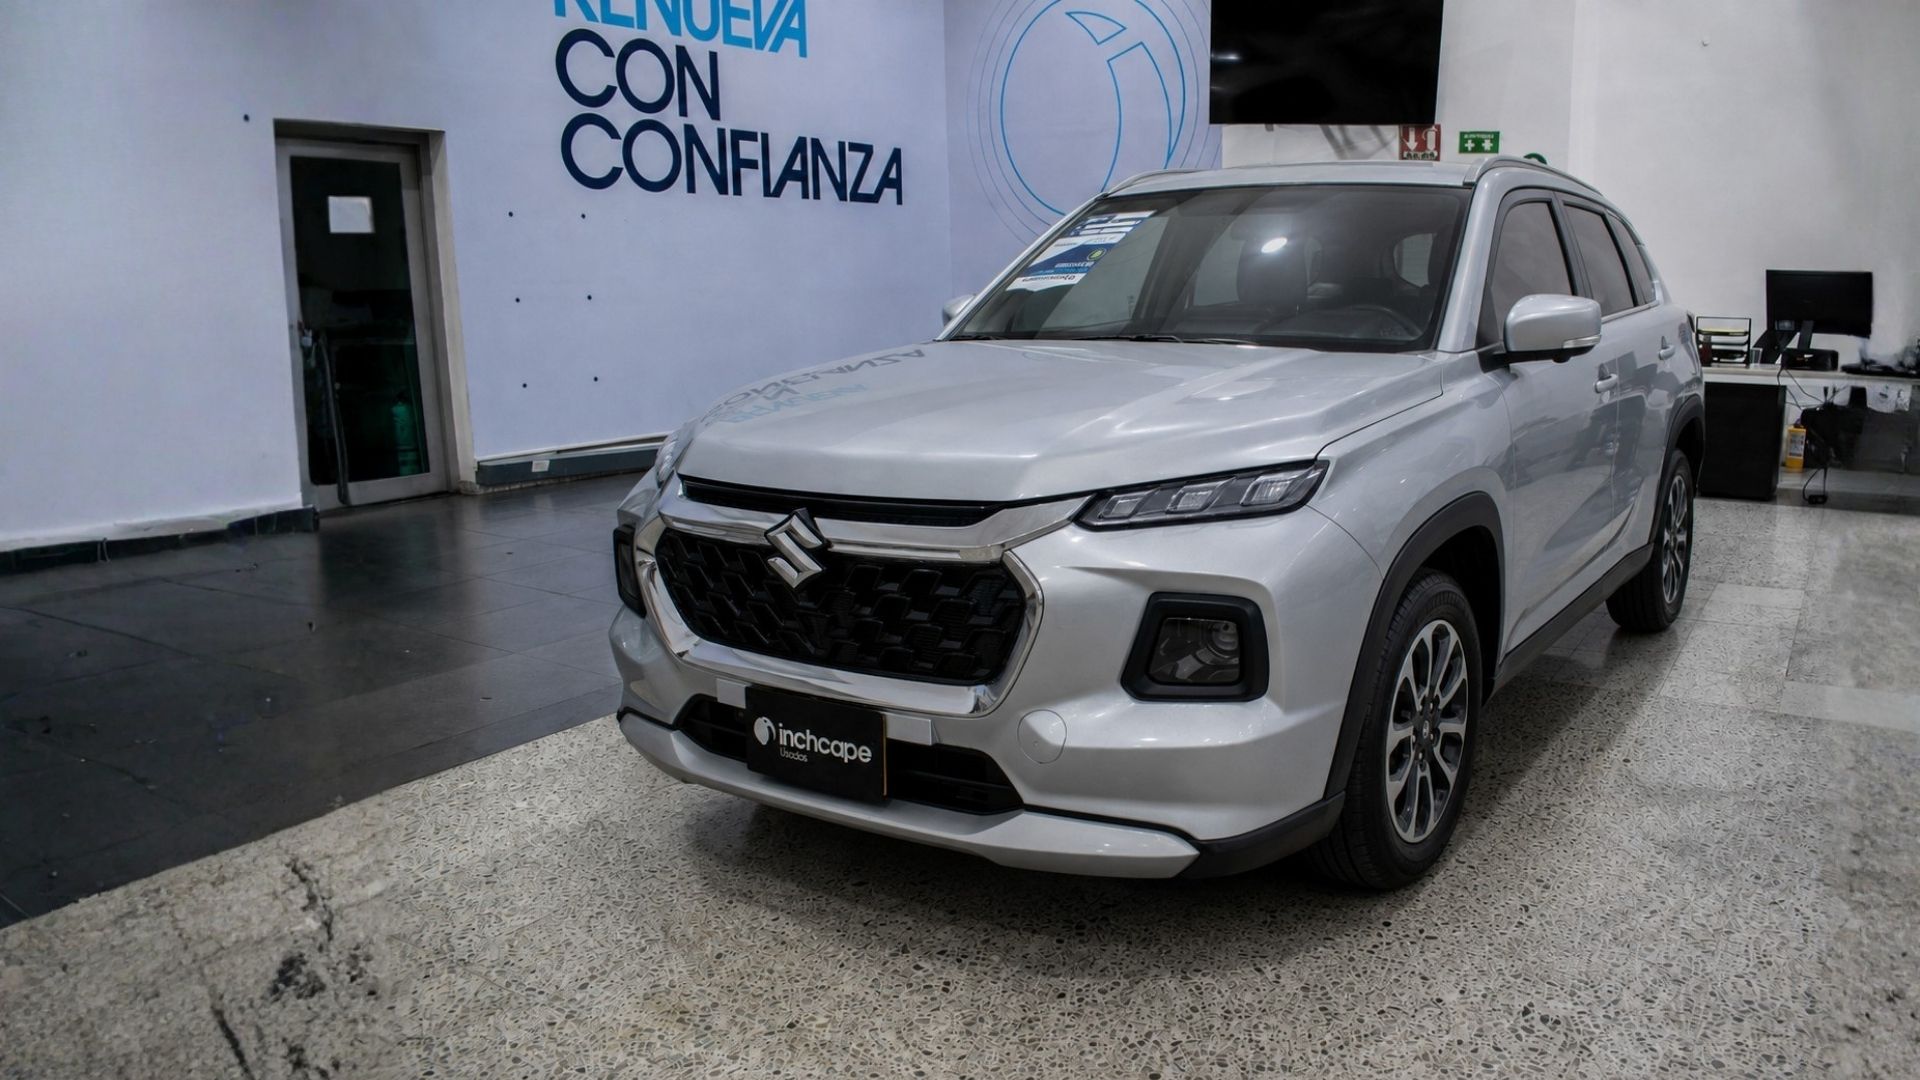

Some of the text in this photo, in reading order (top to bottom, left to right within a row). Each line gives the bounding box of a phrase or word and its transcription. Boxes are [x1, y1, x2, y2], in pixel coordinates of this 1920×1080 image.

[555, 0, 808, 58] UEVA
[555, 28, 721, 121] CON
[561, 112, 903, 206] CONFIANZA
[779, 723, 872, 763] inchcape
[780, 747, 808, 762] Usados
